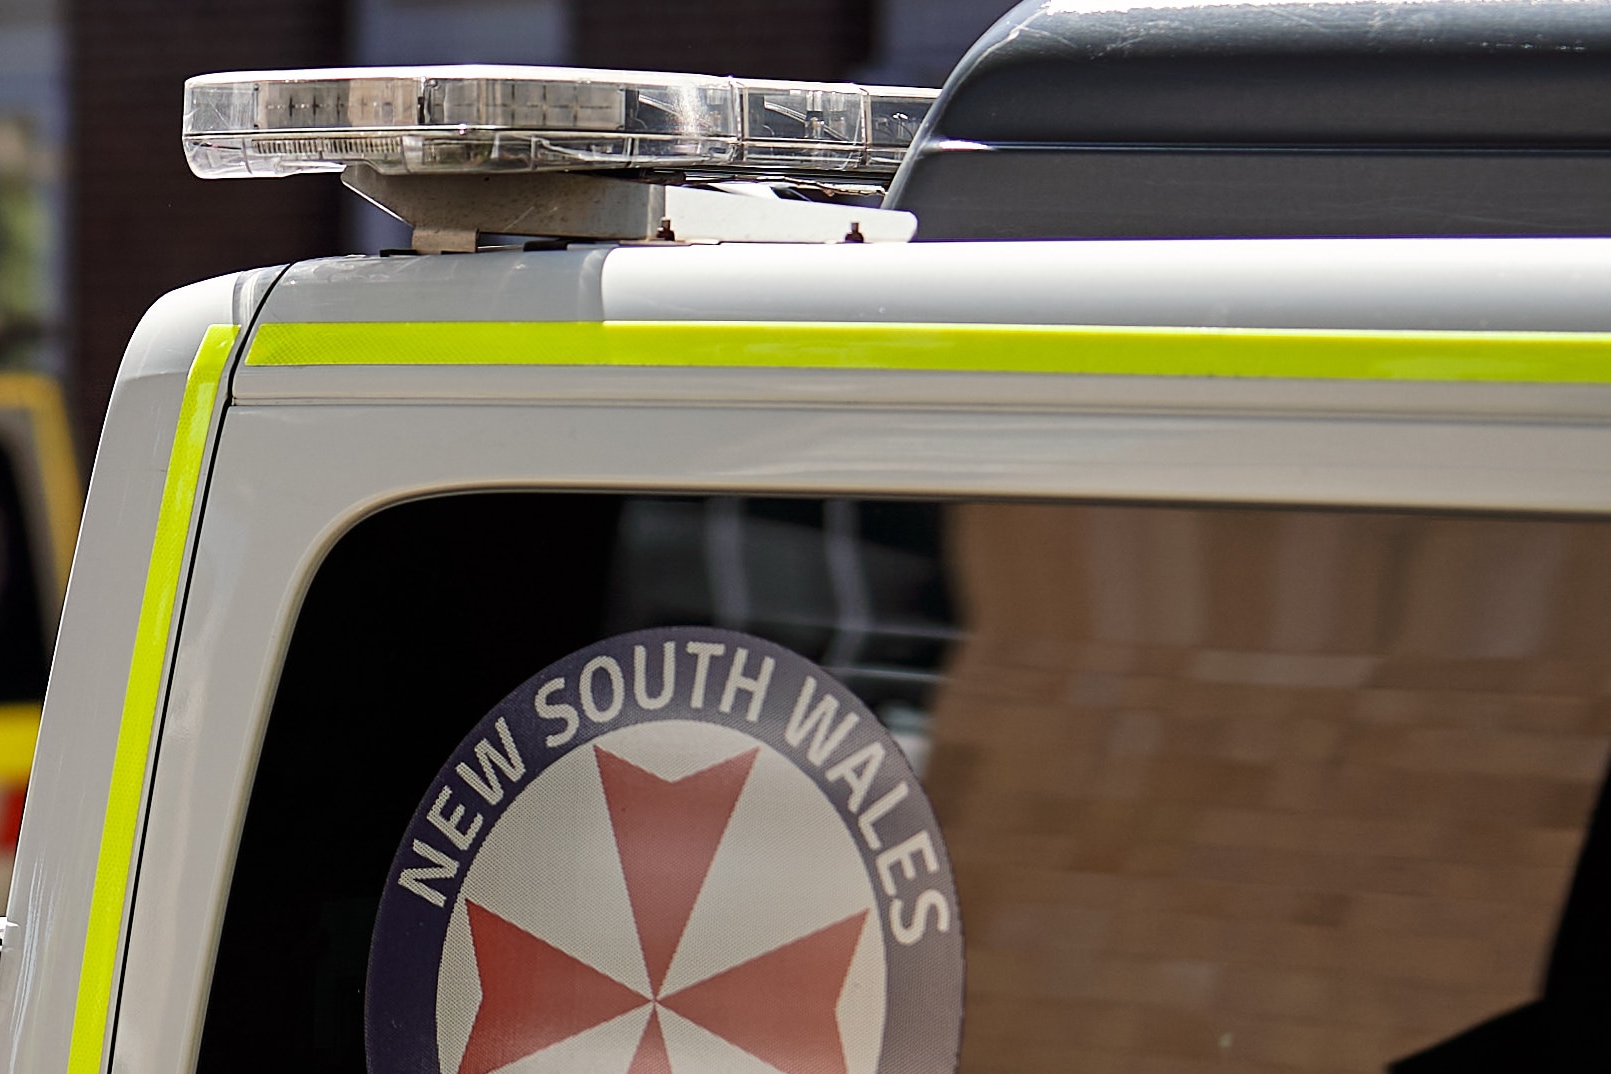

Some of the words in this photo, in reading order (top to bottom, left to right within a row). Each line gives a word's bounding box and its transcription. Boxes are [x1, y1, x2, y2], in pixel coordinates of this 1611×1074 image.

[398, 718, 524, 907] NEW
[533, 641, 775, 748] SOUTH
[784, 676, 949, 946] WALES
